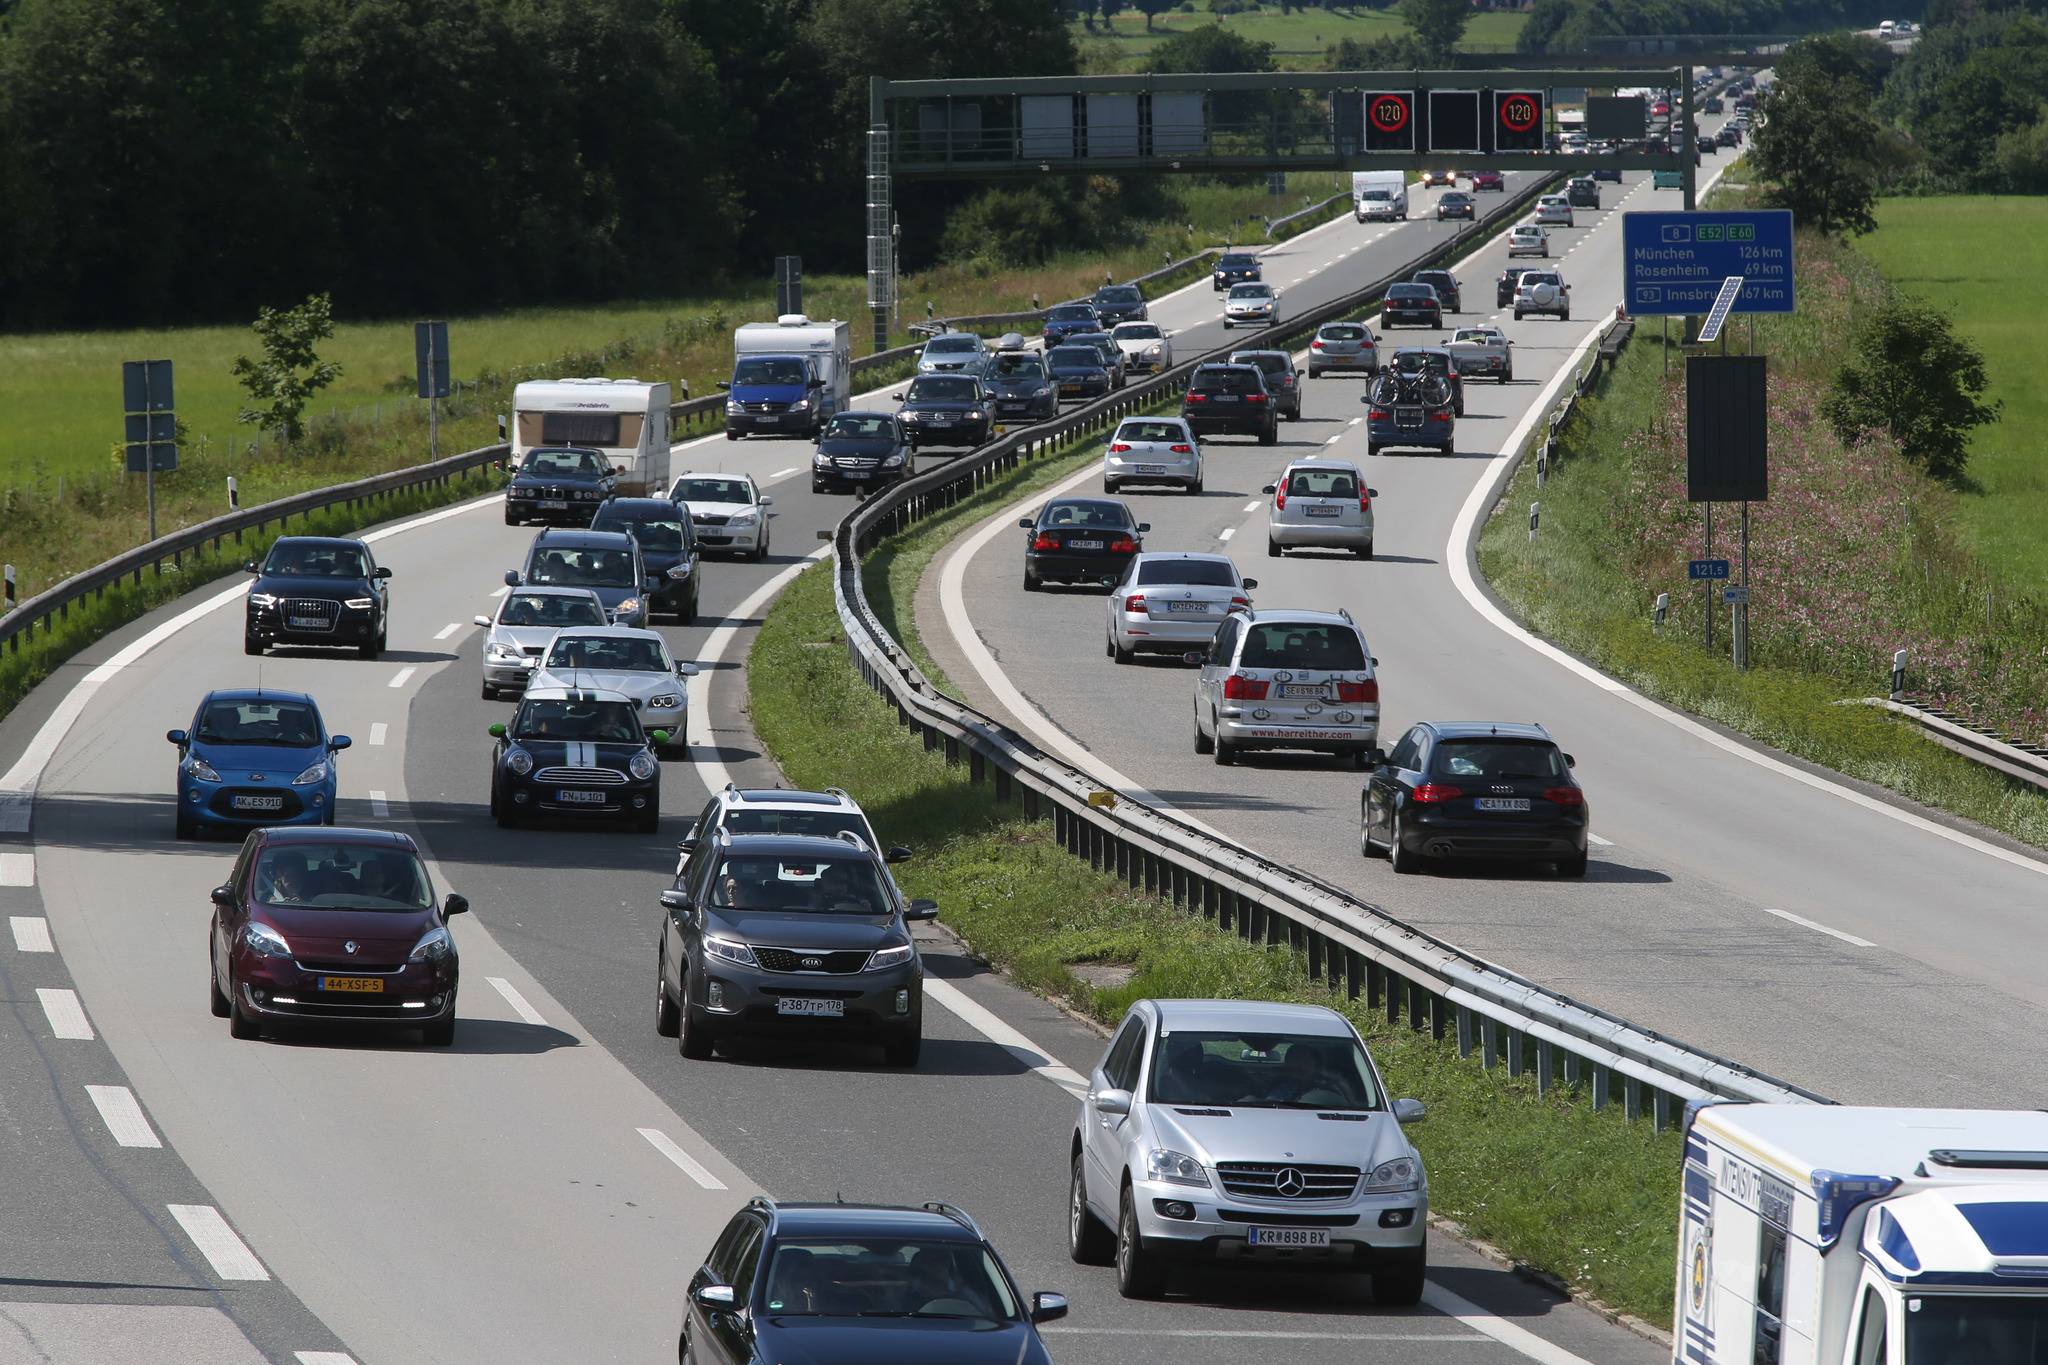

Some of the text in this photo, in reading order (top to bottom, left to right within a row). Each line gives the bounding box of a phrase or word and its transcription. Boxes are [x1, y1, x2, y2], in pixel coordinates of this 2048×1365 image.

[1378, 105, 1400, 121] 120
[1509, 104, 1531, 121] 120
[1672, 228, 1680, 239] 8
[1634, 246, 1783, 260] München 126 km
[1635, 263, 1783, 276] Rosenheim 69 km
[1643, 290, 1655, 300] 93
[1667, 287, 1784, 300] Innsbru 167 km
[1695, 564, 1723, 576] 121.5
[1194, 603, 1208, 611] 229
[1251, 729, 1352, 739] www.harreither.com
[236, 797, 282, 807] AK ES 910
[562, 792, 574, 800] FN
[588, 793, 603, 801] 101
[328, 979, 379, 990] 44-XSF-5
[825, 1000, 842, 1010] 178
[1260, 1230, 1325, 1244] KR 898 BX
